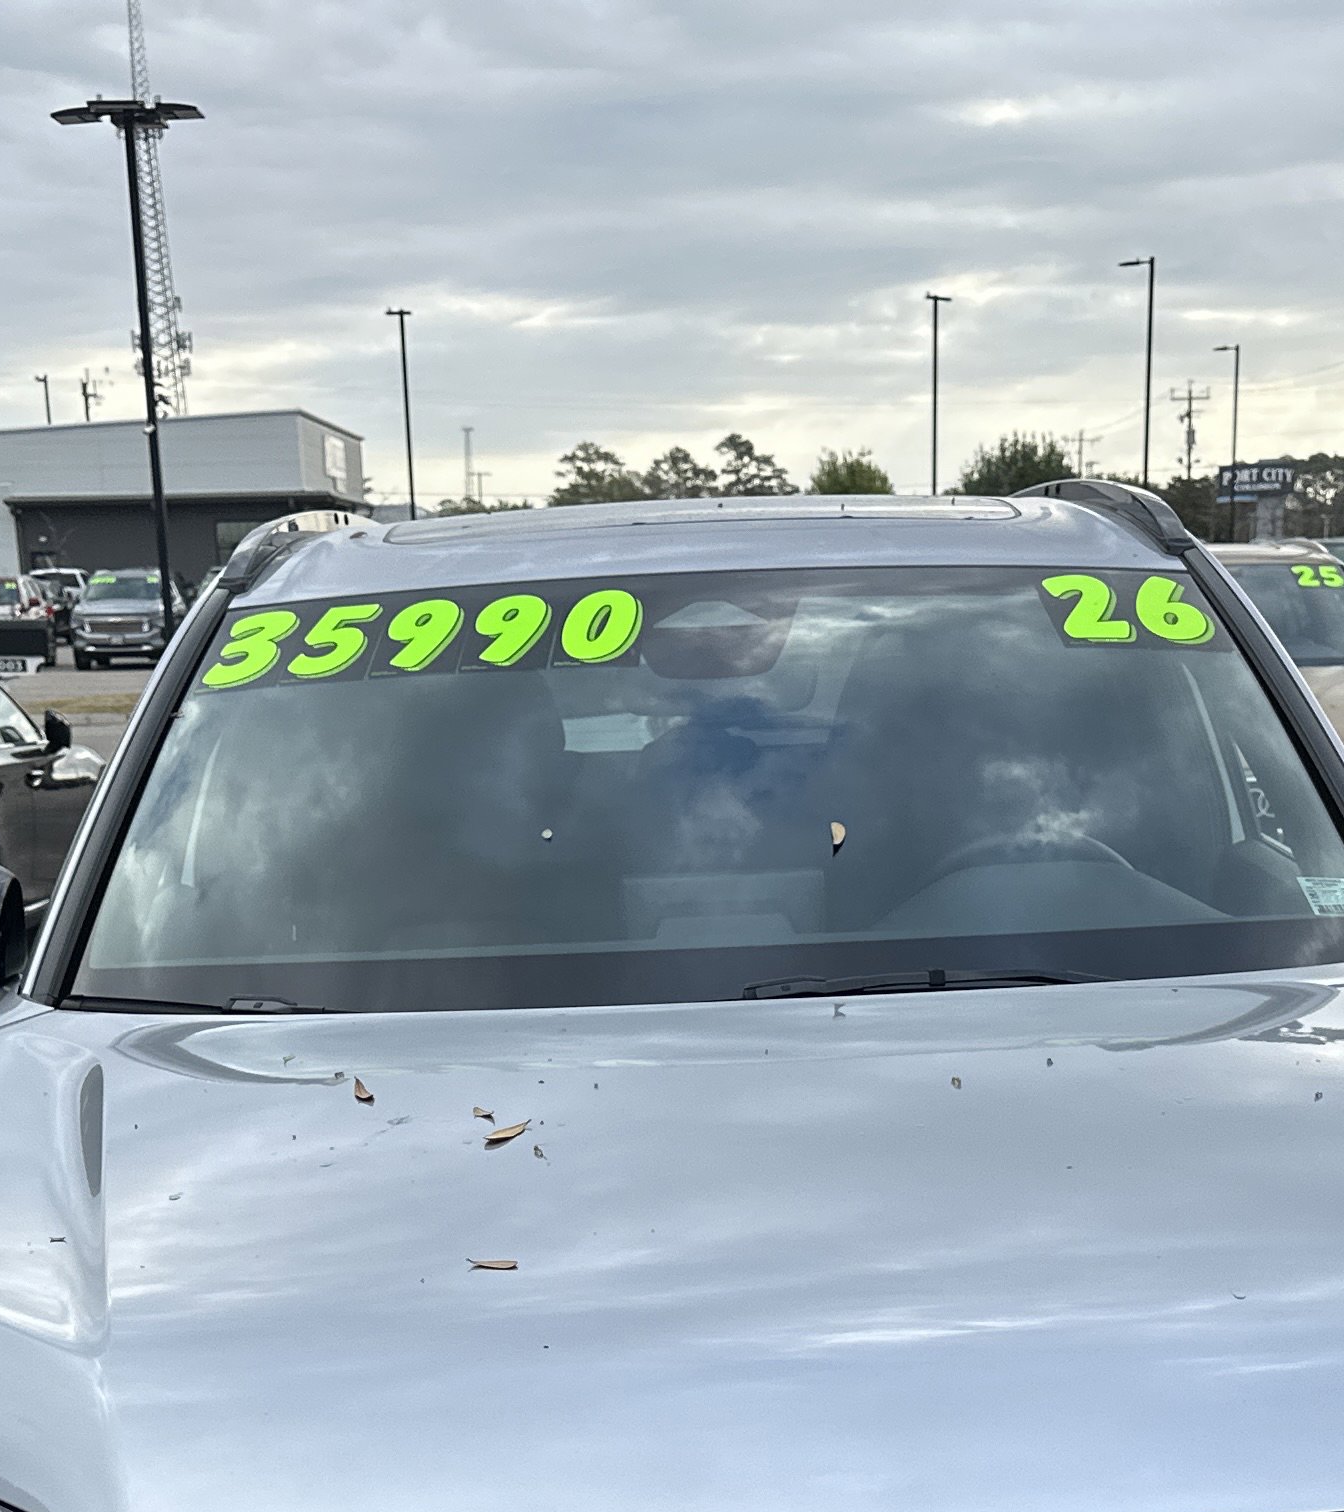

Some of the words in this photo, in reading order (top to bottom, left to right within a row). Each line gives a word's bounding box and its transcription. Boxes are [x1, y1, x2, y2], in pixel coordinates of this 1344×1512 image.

[1262, 467, 1295, 483] CITY
[1291, 565, 1344, 588] 25
[1042, 574, 1215, 644] 26
[202, 589, 643, 689] 35990
